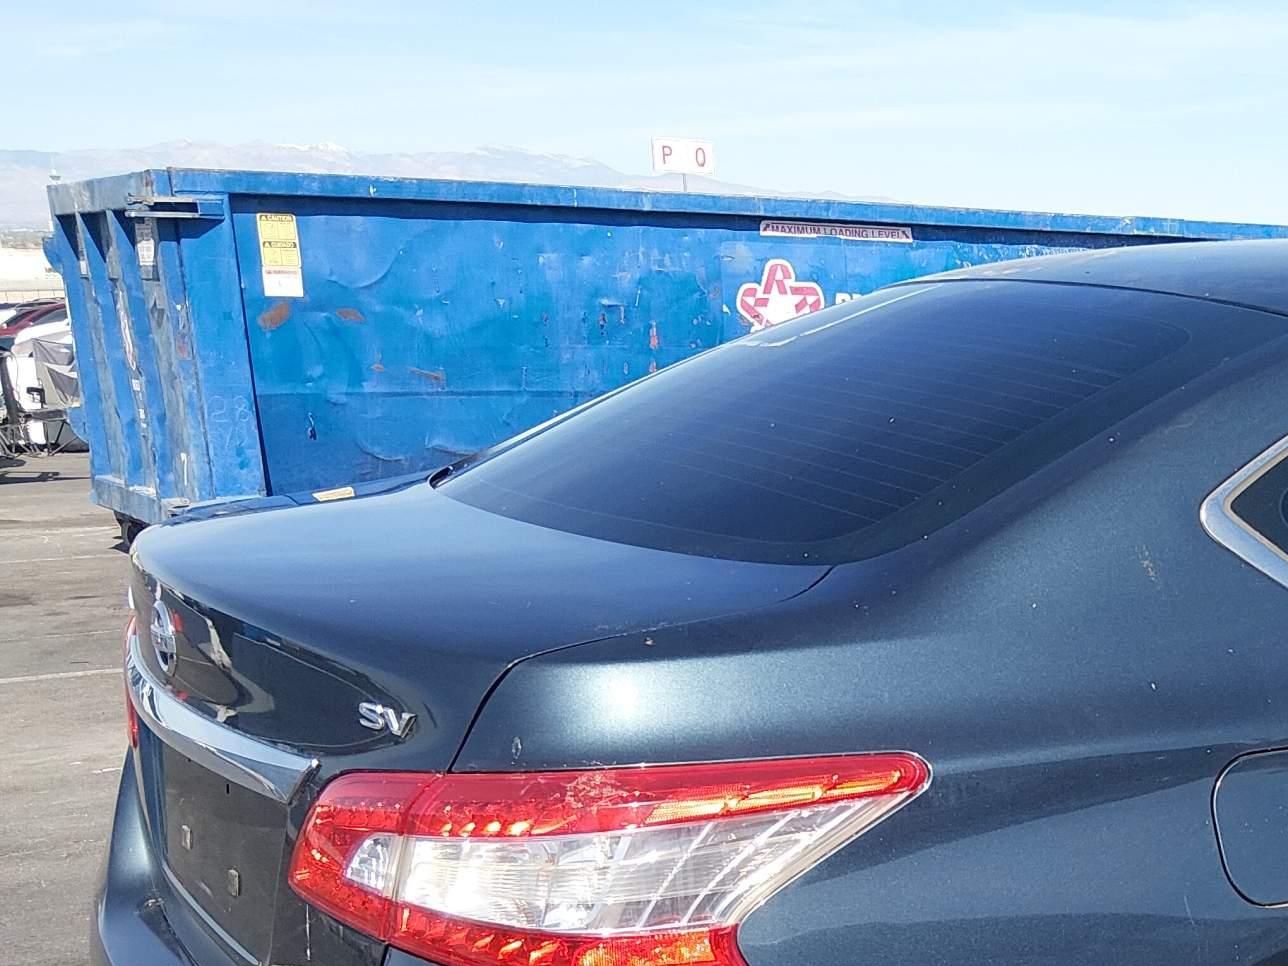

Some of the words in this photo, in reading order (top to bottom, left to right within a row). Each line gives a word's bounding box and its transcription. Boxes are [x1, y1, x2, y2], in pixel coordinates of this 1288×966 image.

[662, 145, 673, 164] P
[771, 223, 821, 235] MAXIMUM
[824, 227, 869, 238] LOADING
[872, 230, 901, 239] LEVEL
[359, 702, 417, 738] SV
